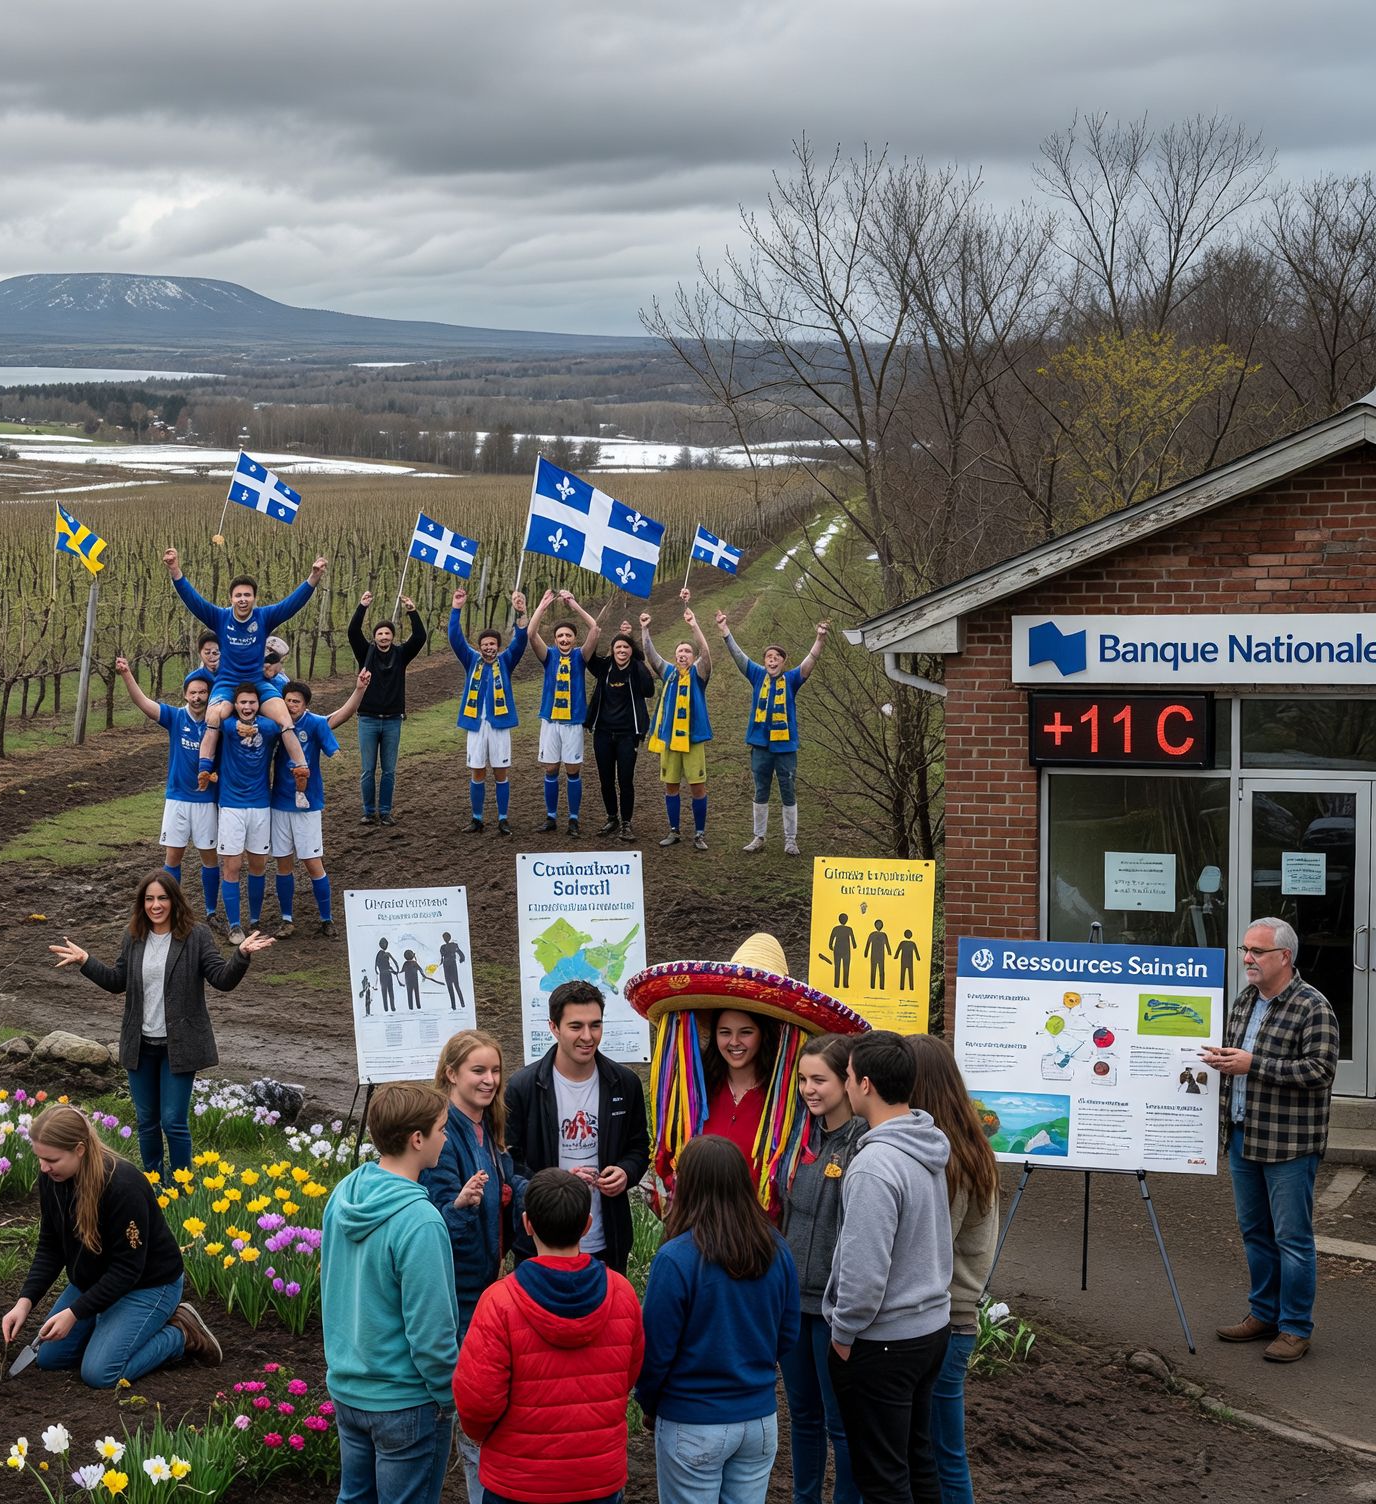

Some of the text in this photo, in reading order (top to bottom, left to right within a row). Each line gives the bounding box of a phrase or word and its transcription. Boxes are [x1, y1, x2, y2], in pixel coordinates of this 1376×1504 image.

[1099, 633, 1376, 671] Banque Nationale
[1043, 704, 1195, 755] +11 C
[1002, 951, 1122, 975] Ressources
